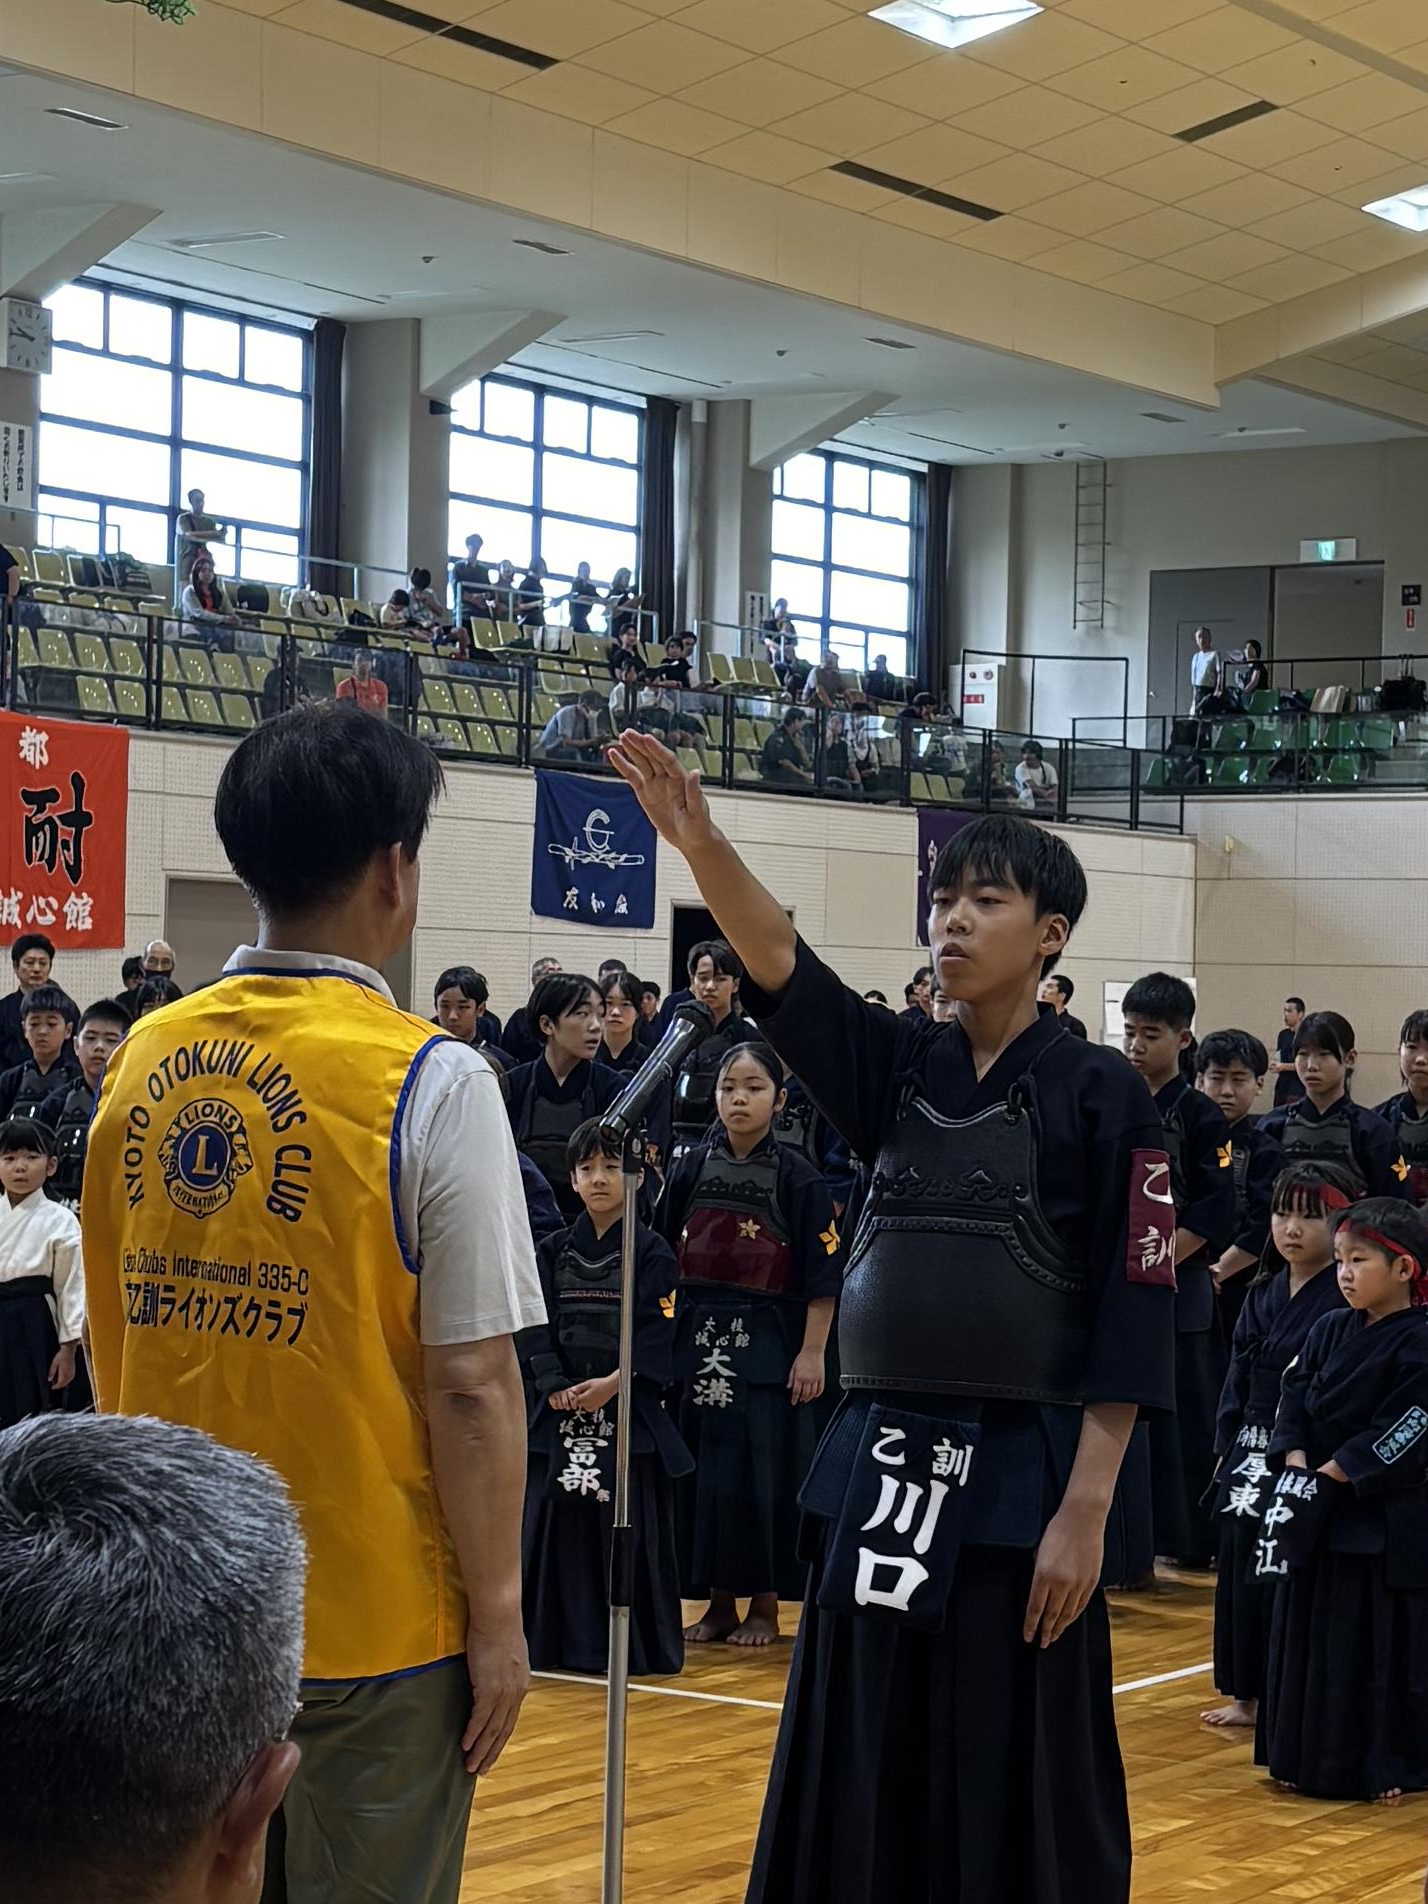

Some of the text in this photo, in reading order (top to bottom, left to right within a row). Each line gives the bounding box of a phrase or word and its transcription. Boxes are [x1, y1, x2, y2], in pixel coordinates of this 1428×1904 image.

[148, 1039, 255, 1102] OTOKUNI
[246, 1052, 307, 1133] LIONS
[184, 1103, 238, 1130] LIONS
[192, 1135, 218, 1176] L
[267, 1144, 312, 1222] CLUB
[1134, 1161, 1174, 1272] 乙訓
[258, 1262, 310, 1295] 335-C
[693, 1348, 738, 1408] 大溝
[871, 1426, 974, 1486] 乙訓
[1221, 1452, 1272, 1518] 厚東
[854, 1473, 950, 1612] 川口
[1255, 1497, 1295, 1576] 中江
